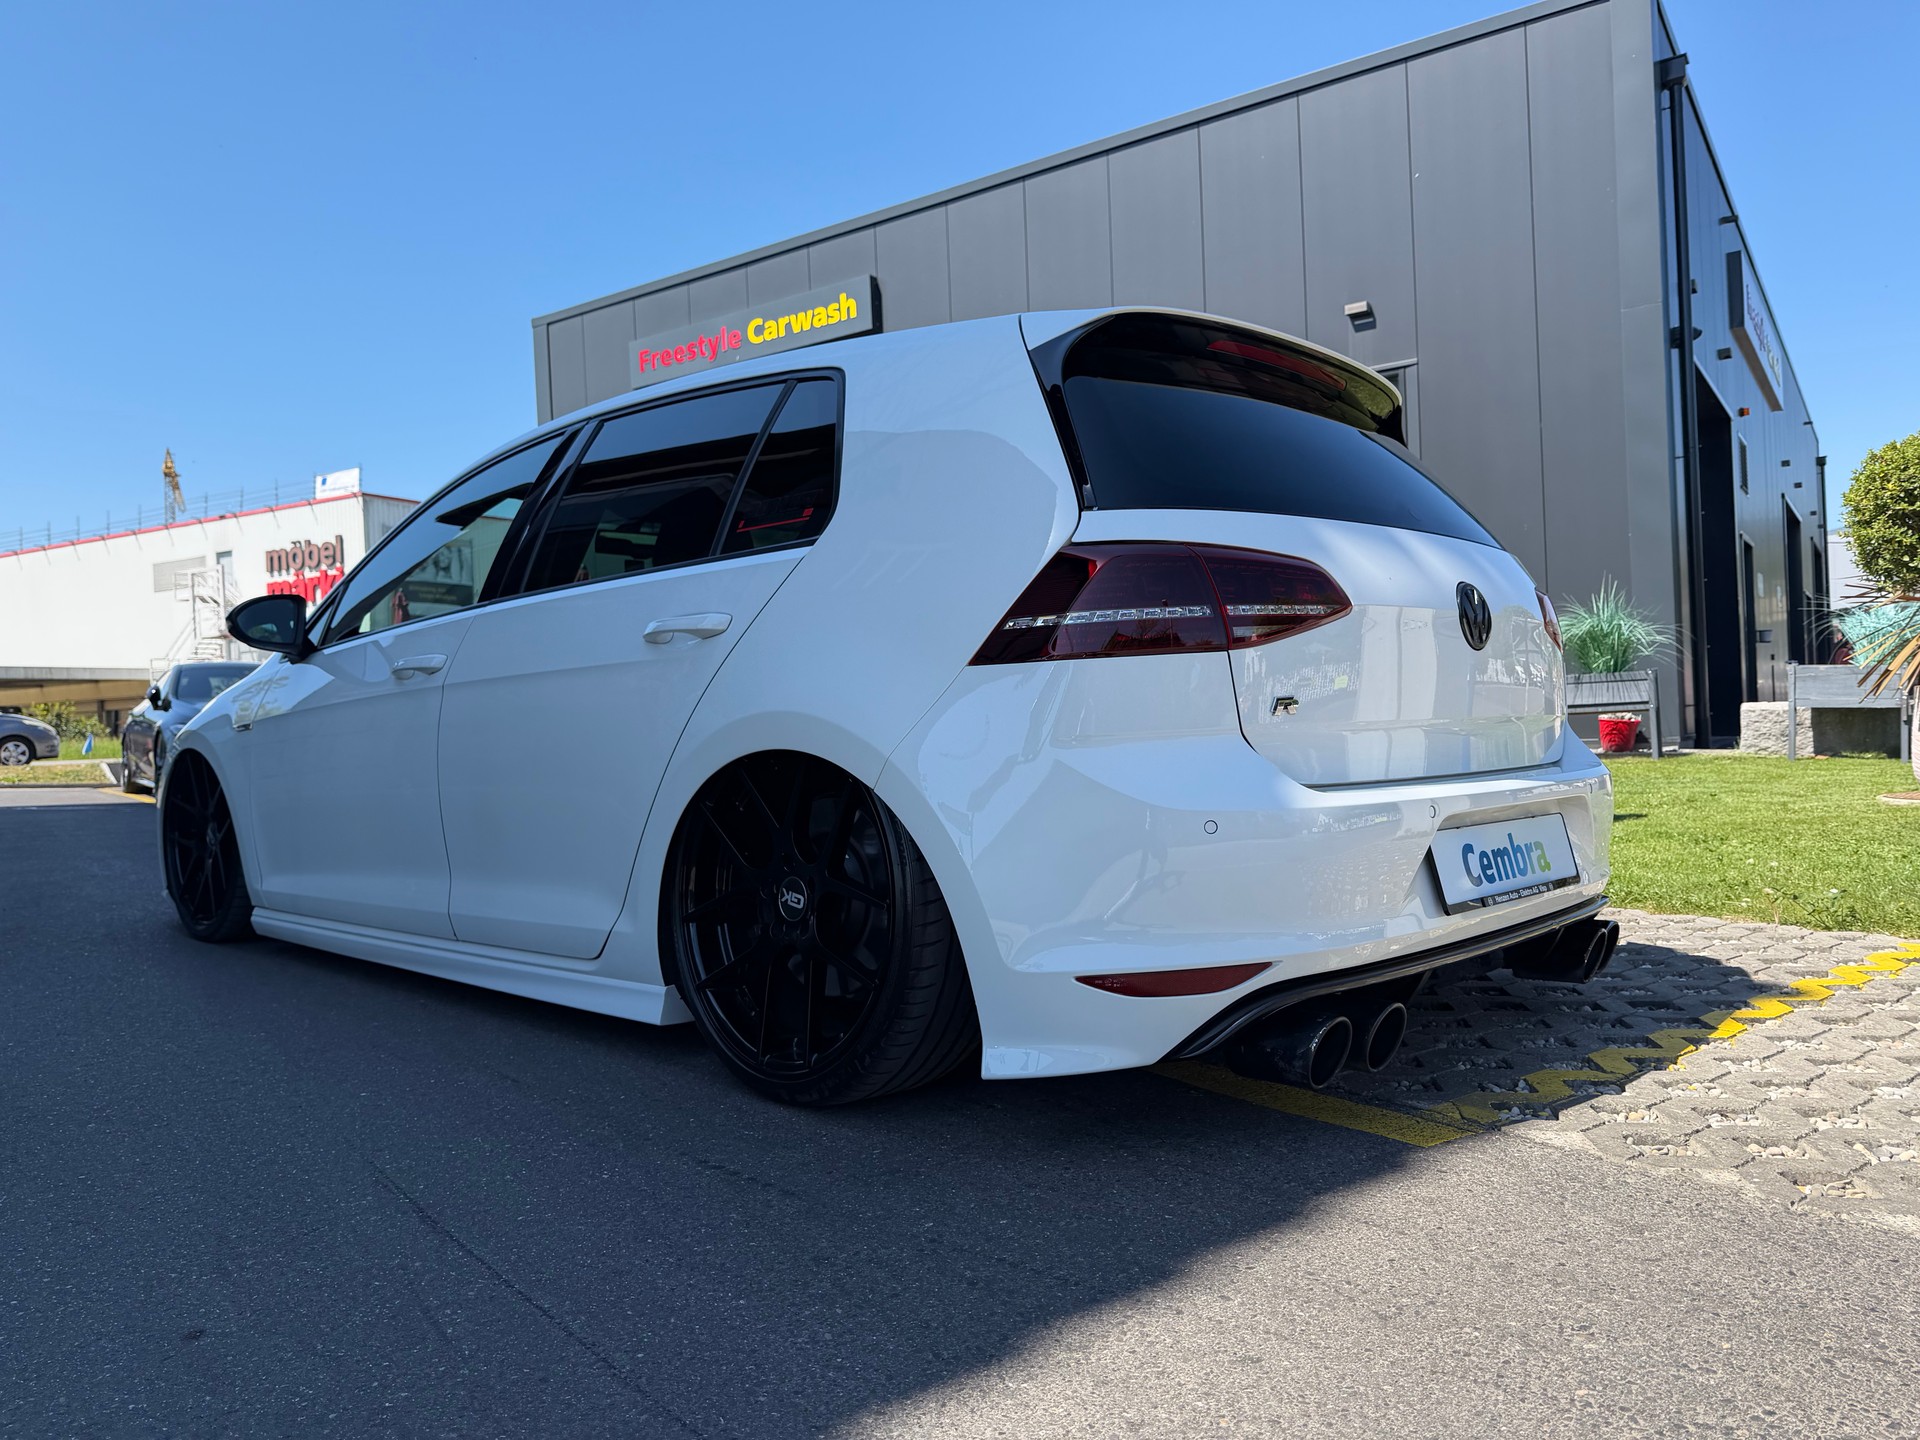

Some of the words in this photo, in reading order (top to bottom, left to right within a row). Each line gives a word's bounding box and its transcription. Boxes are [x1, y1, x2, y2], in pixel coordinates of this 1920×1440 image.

[638, 326, 742, 374] Freestyle
[747, 292, 858, 344] Carwash
[266, 534, 343, 572] möbel
[1461, 832, 1551, 888] Cembra
